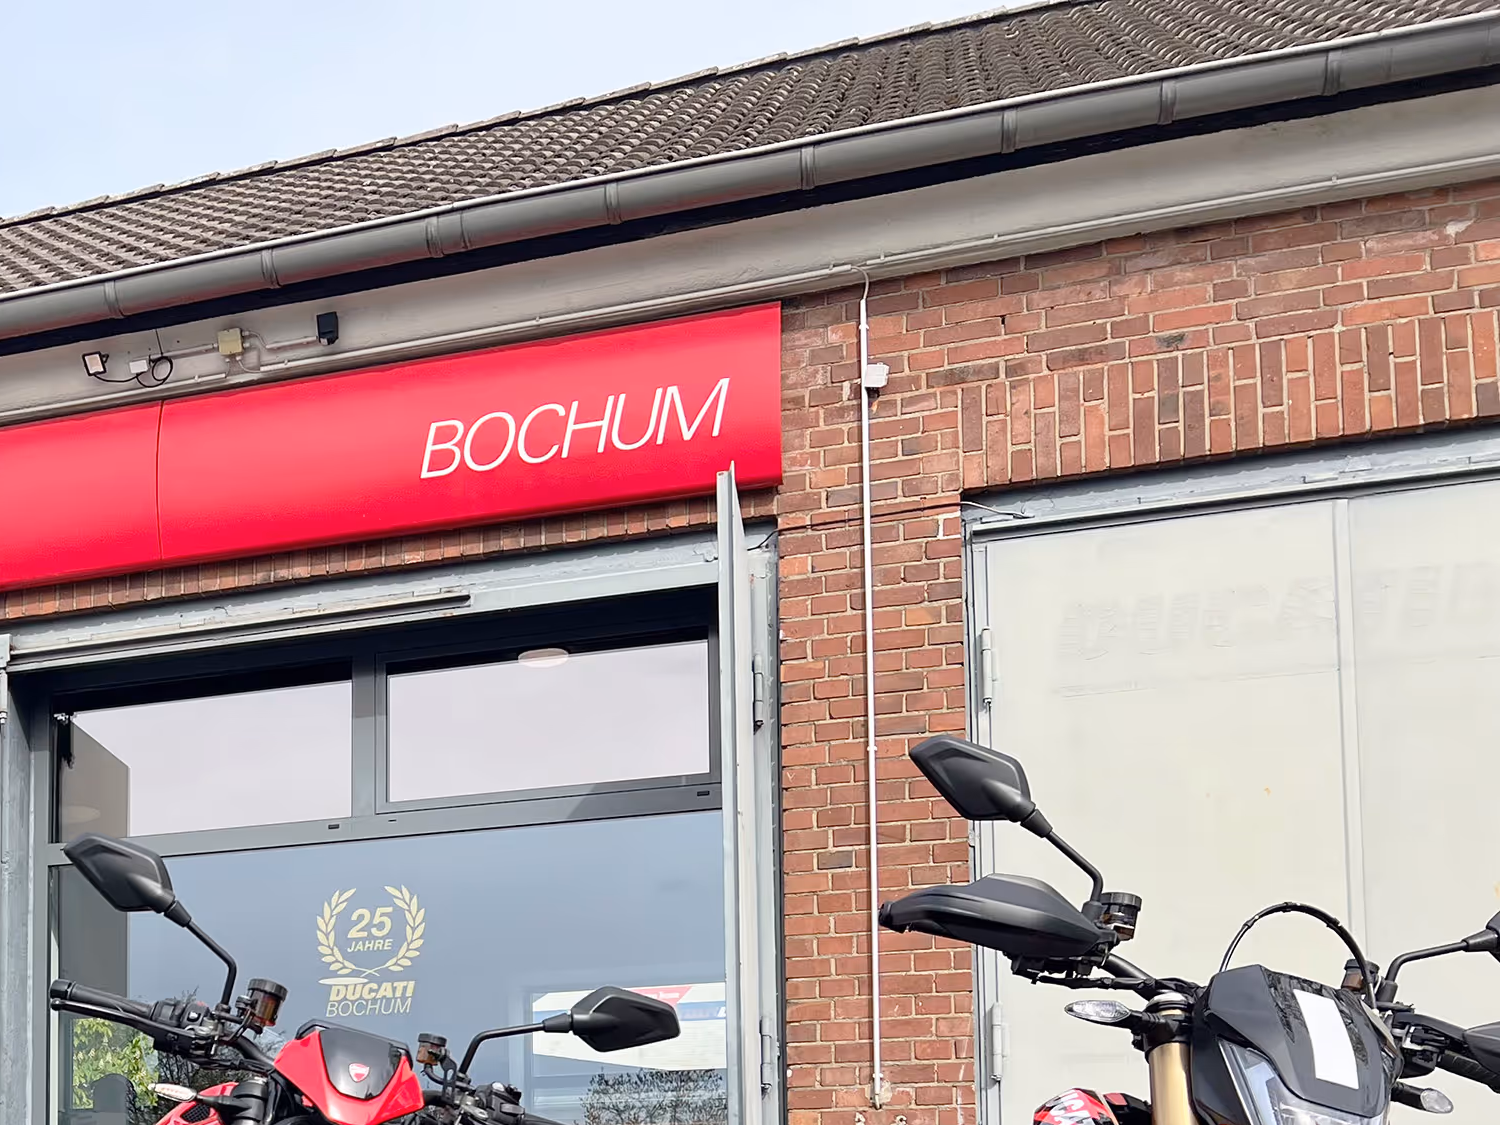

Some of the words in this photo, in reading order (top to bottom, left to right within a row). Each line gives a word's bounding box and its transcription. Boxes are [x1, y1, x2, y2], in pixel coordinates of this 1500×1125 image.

[420, 377, 730, 479] BOCHUM
[347, 907, 394, 939] 25
[347, 939, 394, 953] JAHRE
[329, 980, 416, 1001] DUCATI
[325, 998, 412, 1018] BOCHUM
